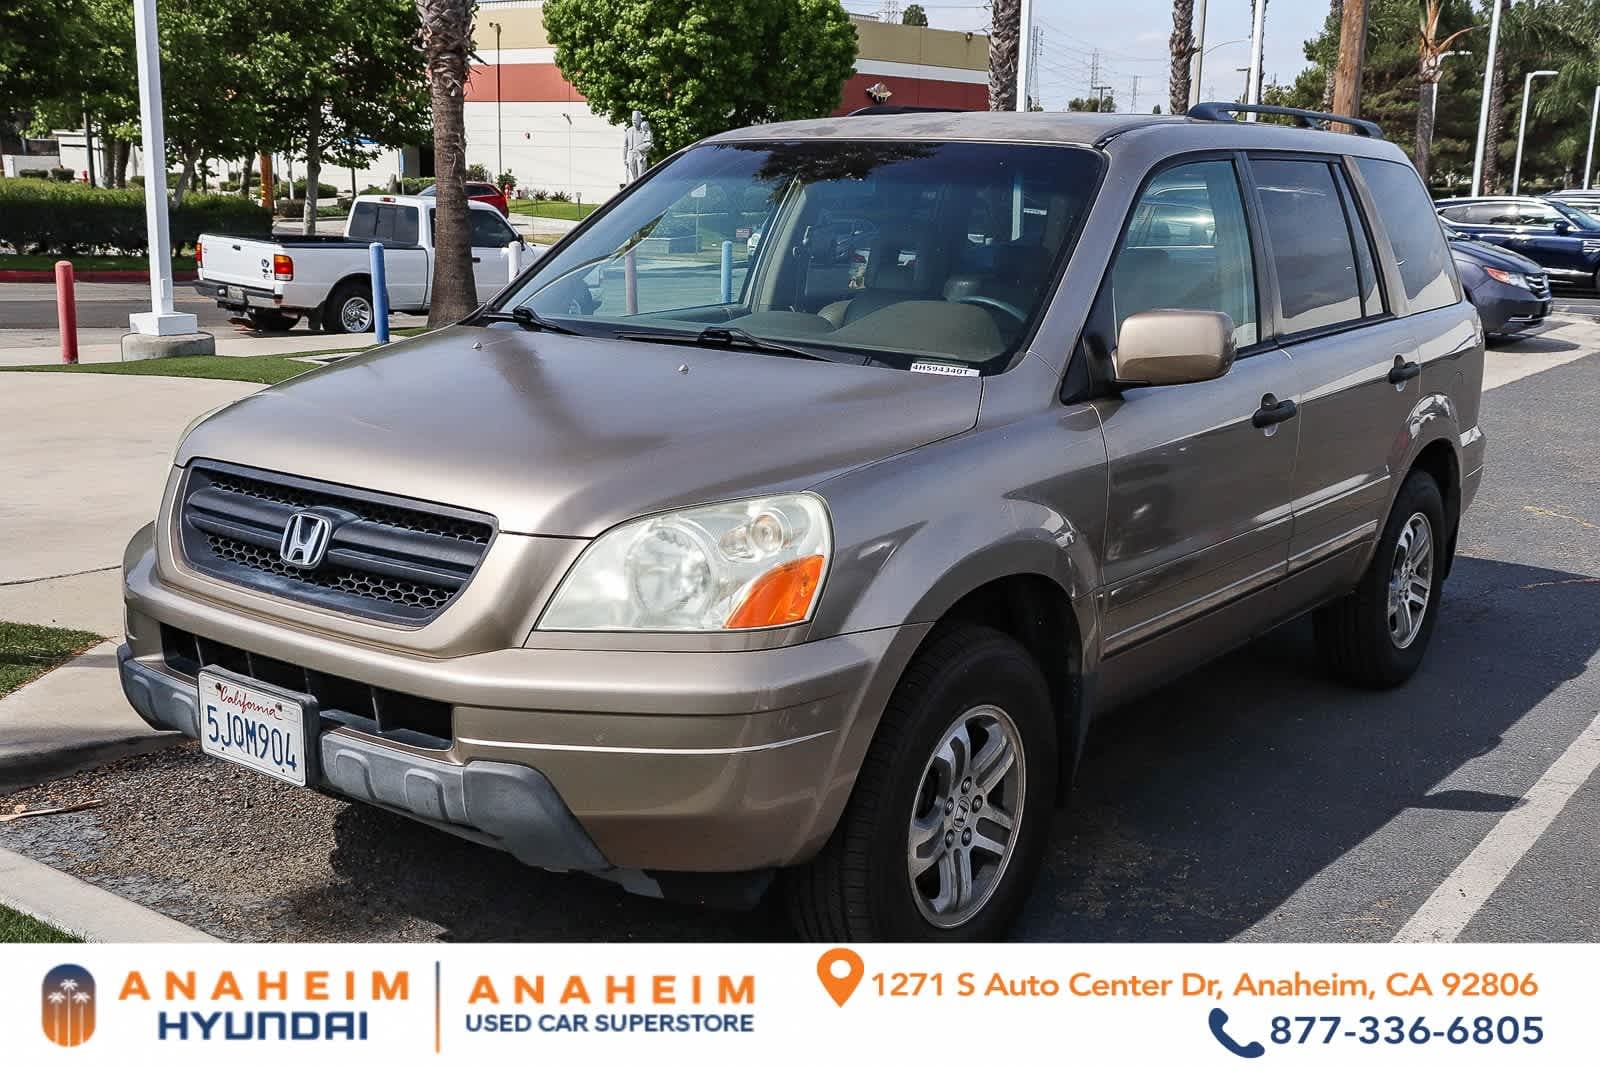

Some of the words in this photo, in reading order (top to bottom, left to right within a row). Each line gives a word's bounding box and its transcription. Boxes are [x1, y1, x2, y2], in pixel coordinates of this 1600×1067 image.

[284, 513, 328, 566] H
[220, 685, 283, 720] California
[206, 704, 297, 772] 5JQM904
